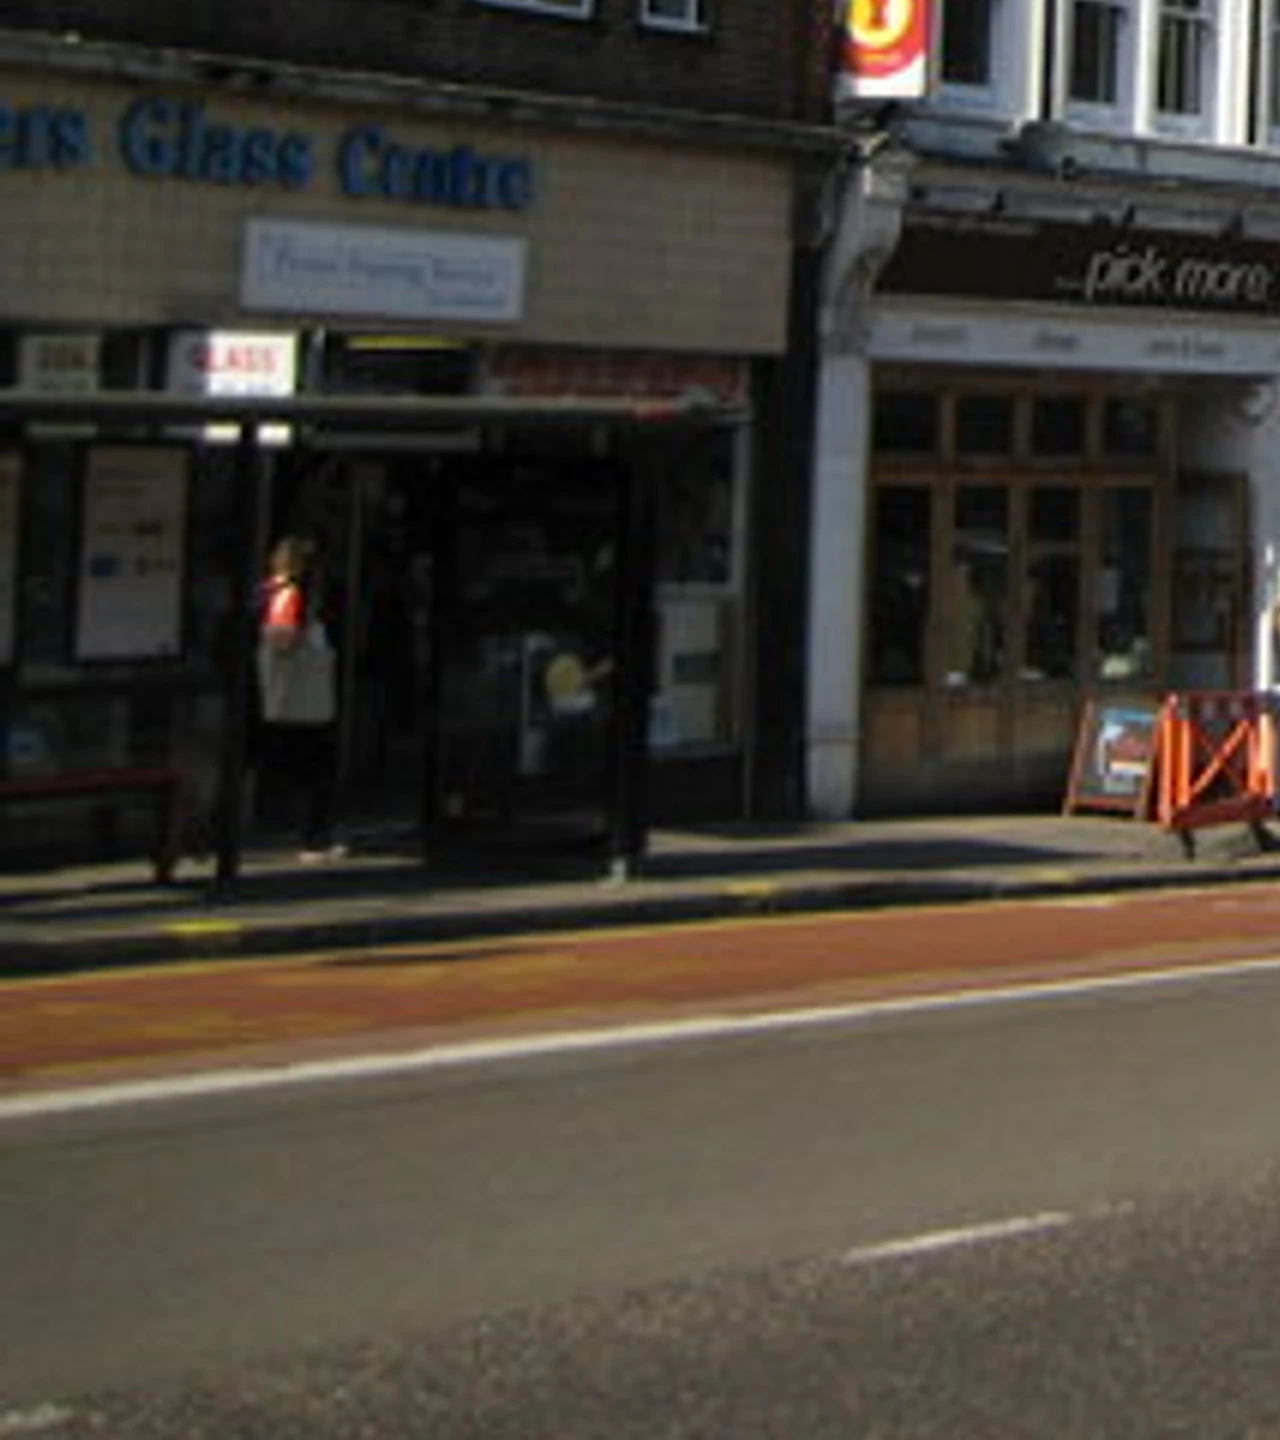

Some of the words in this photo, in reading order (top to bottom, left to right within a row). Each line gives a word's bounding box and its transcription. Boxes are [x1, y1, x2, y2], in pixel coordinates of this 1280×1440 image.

[117, 92, 314, 188] Glass
[335, 123, 539, 210] Centre
[1175, 257, 1269, 303] more
